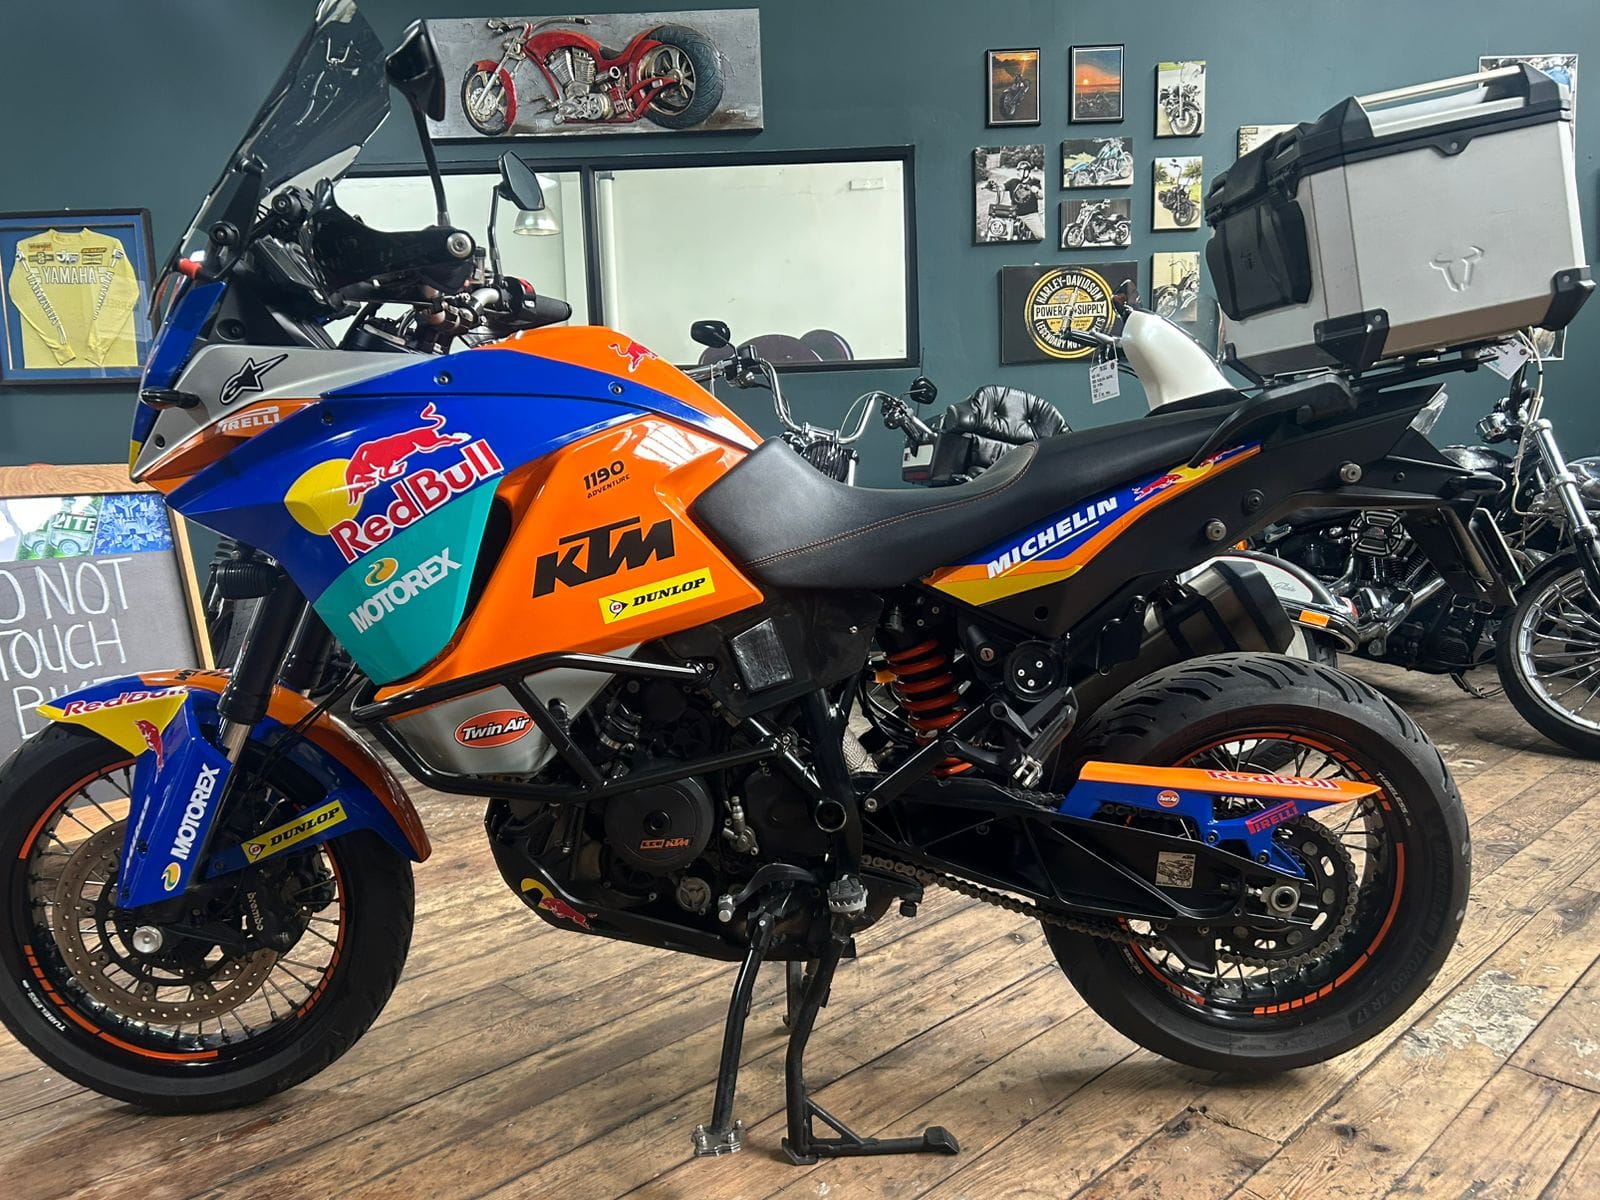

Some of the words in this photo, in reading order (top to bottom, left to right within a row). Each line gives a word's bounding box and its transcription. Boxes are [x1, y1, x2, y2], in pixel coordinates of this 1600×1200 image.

[42, 266, 96, 284] YAMAHA
[1036, 274, 1104, 304] HARLEY-DAVIDSON
[1036, 305, 1062, 317] POWER
[1077, 303, 1105, 317] SUPPLY
[1035, 320, 1066, 348] LEGENDARY
[583, 460, 625, 490] 1190
[587, 473, 630, 499] ADVENTURE
[986, 497, 1119, 580] MICHELIN
[532, 516, 676, 599] KTM
[34, 557, 132, 620] NOT
[348, 547, 463, 634] MOTOREX
[632, 577, 706, 607] DUNLOP
[0, 618, 127, 681] TOUCH
[463, 722, 503, 741] Twin
[502, 717, 530, 733] Air
[170, 763, 221, 861] MOTOREX
[270, 806, 340, 847] DUNLOP
[1245, 800, 1299, 835] PIRELLI
